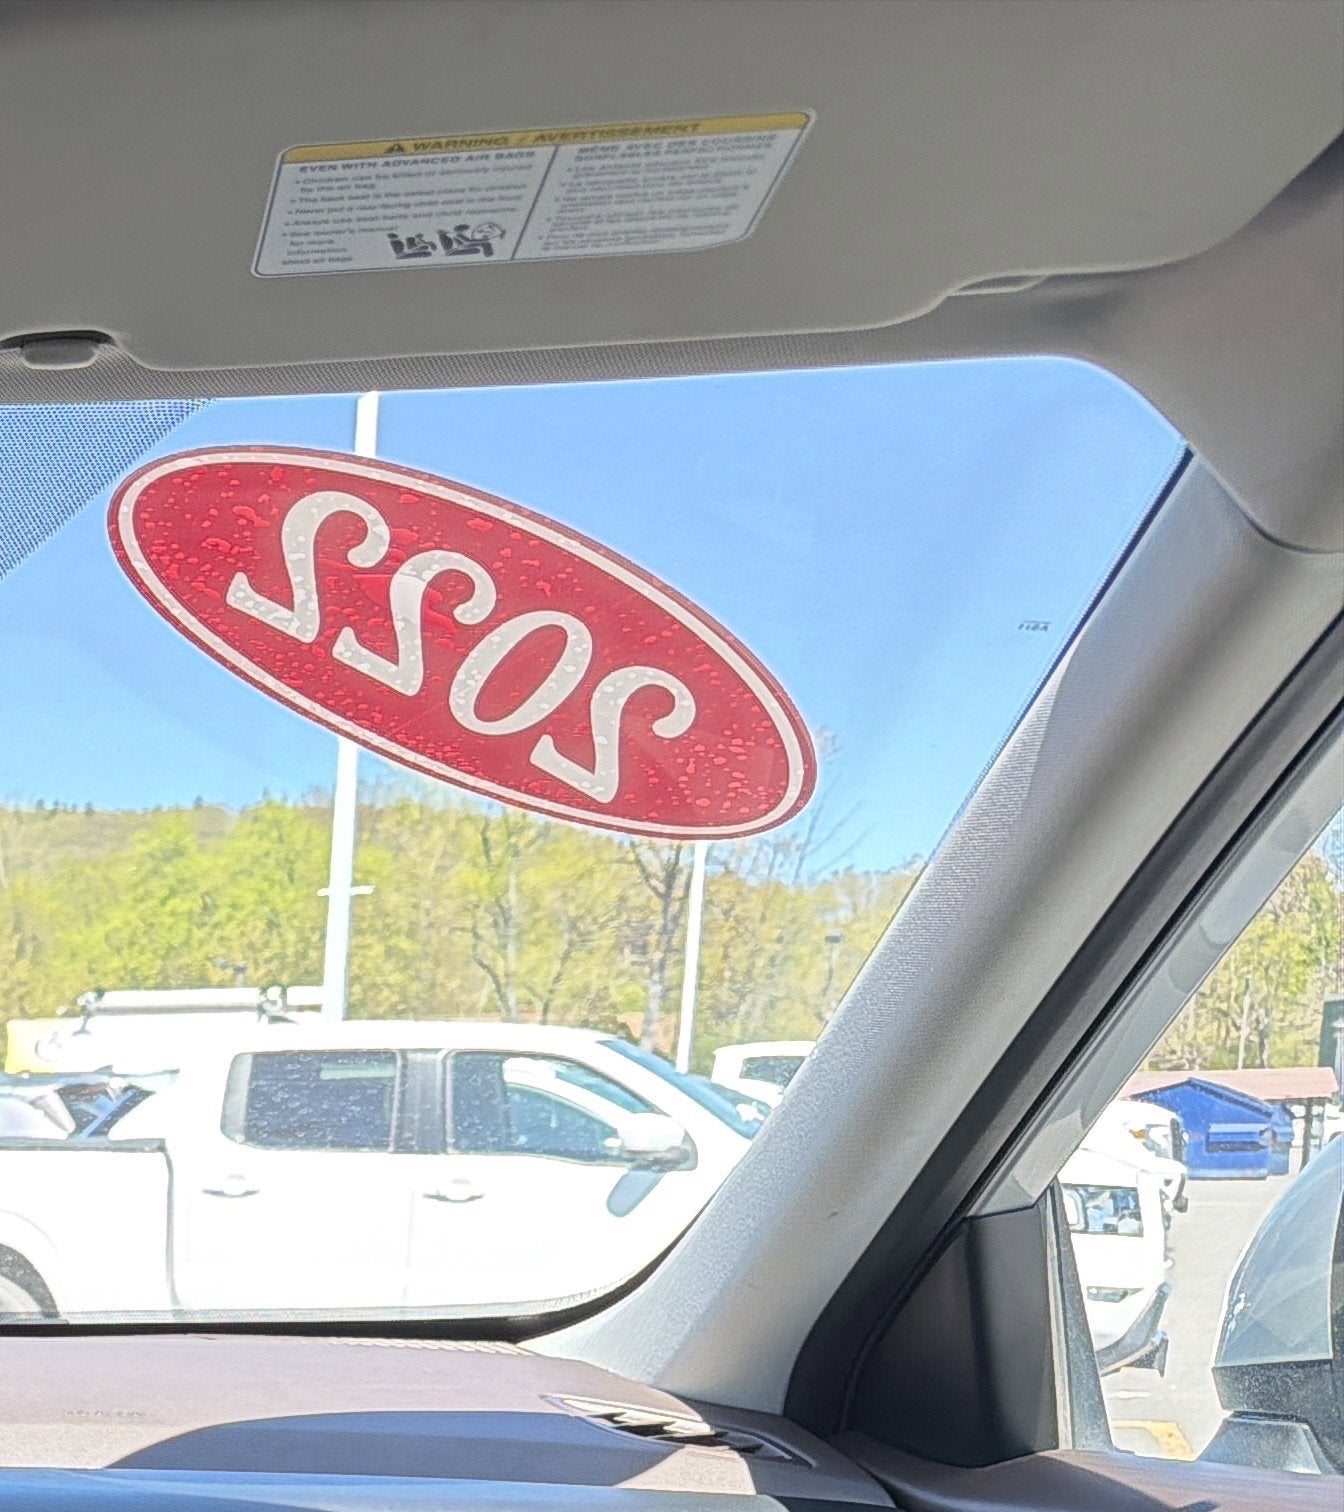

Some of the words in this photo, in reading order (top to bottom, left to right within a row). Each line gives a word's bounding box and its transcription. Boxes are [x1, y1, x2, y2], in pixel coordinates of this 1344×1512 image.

[413, 137, 509, 151] WARNING
[299, 164, 338, 173] EVEN
[341, 162, 377, 170] WITH
[382, 156, 460, 167] ADVANCED
[466, 154, 490, 162] AIR
